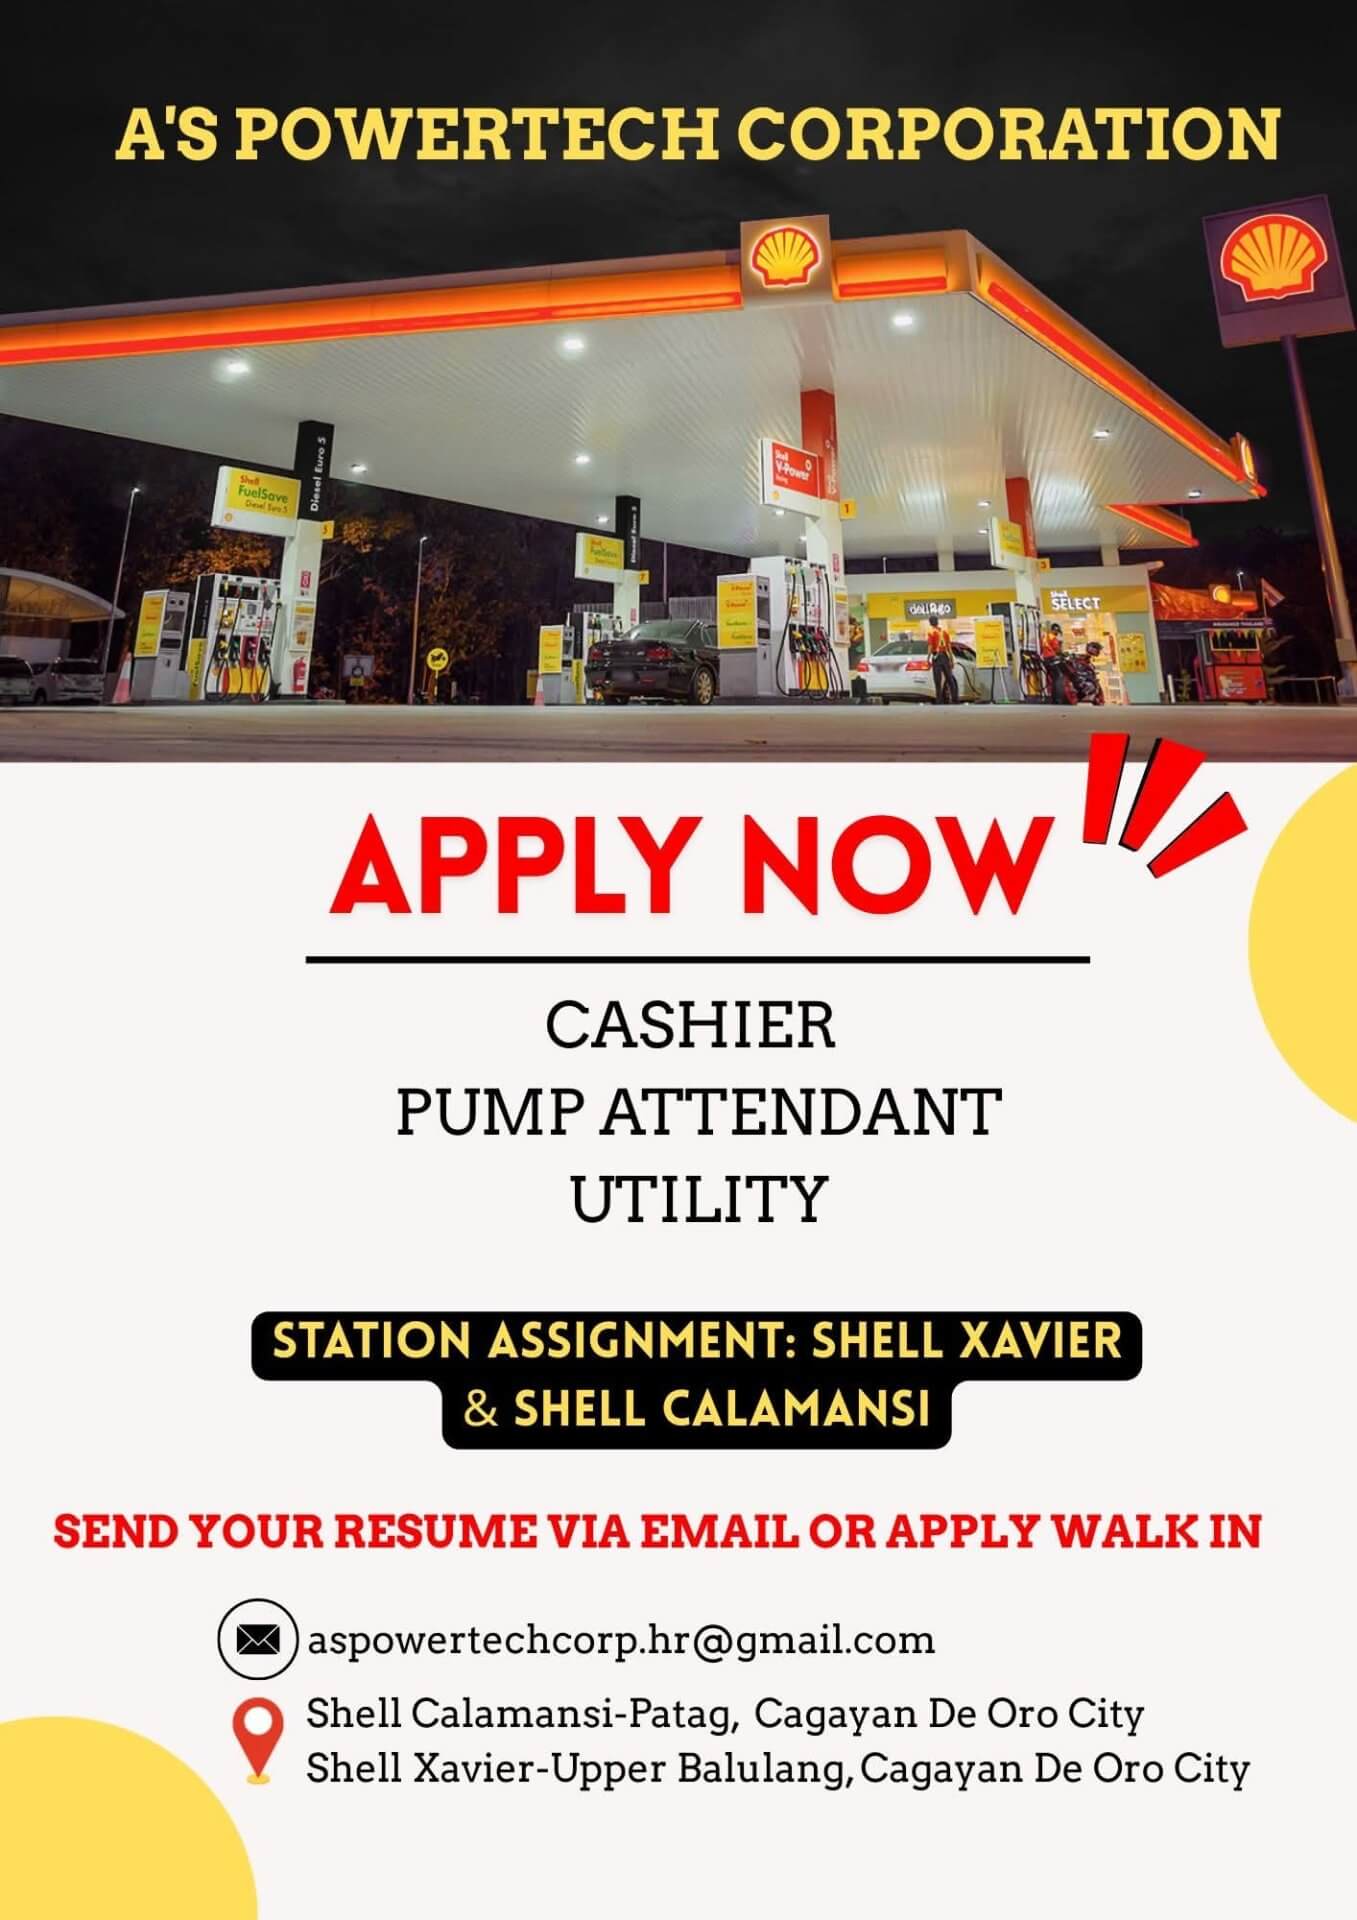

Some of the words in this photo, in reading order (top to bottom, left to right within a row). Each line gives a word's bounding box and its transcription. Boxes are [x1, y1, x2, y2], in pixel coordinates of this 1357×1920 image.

[314, 447, 325, 473] Euro
[776, 460, 809, 481] V-Power
[240, 475, 260, 486] Shell
[238, 485, 288, 504] FuelSave
[310, 476, 322, 512] Diesel
[245, 499, 265, 510] Diesel
[1051, 597, 1101, 611] SELECT
